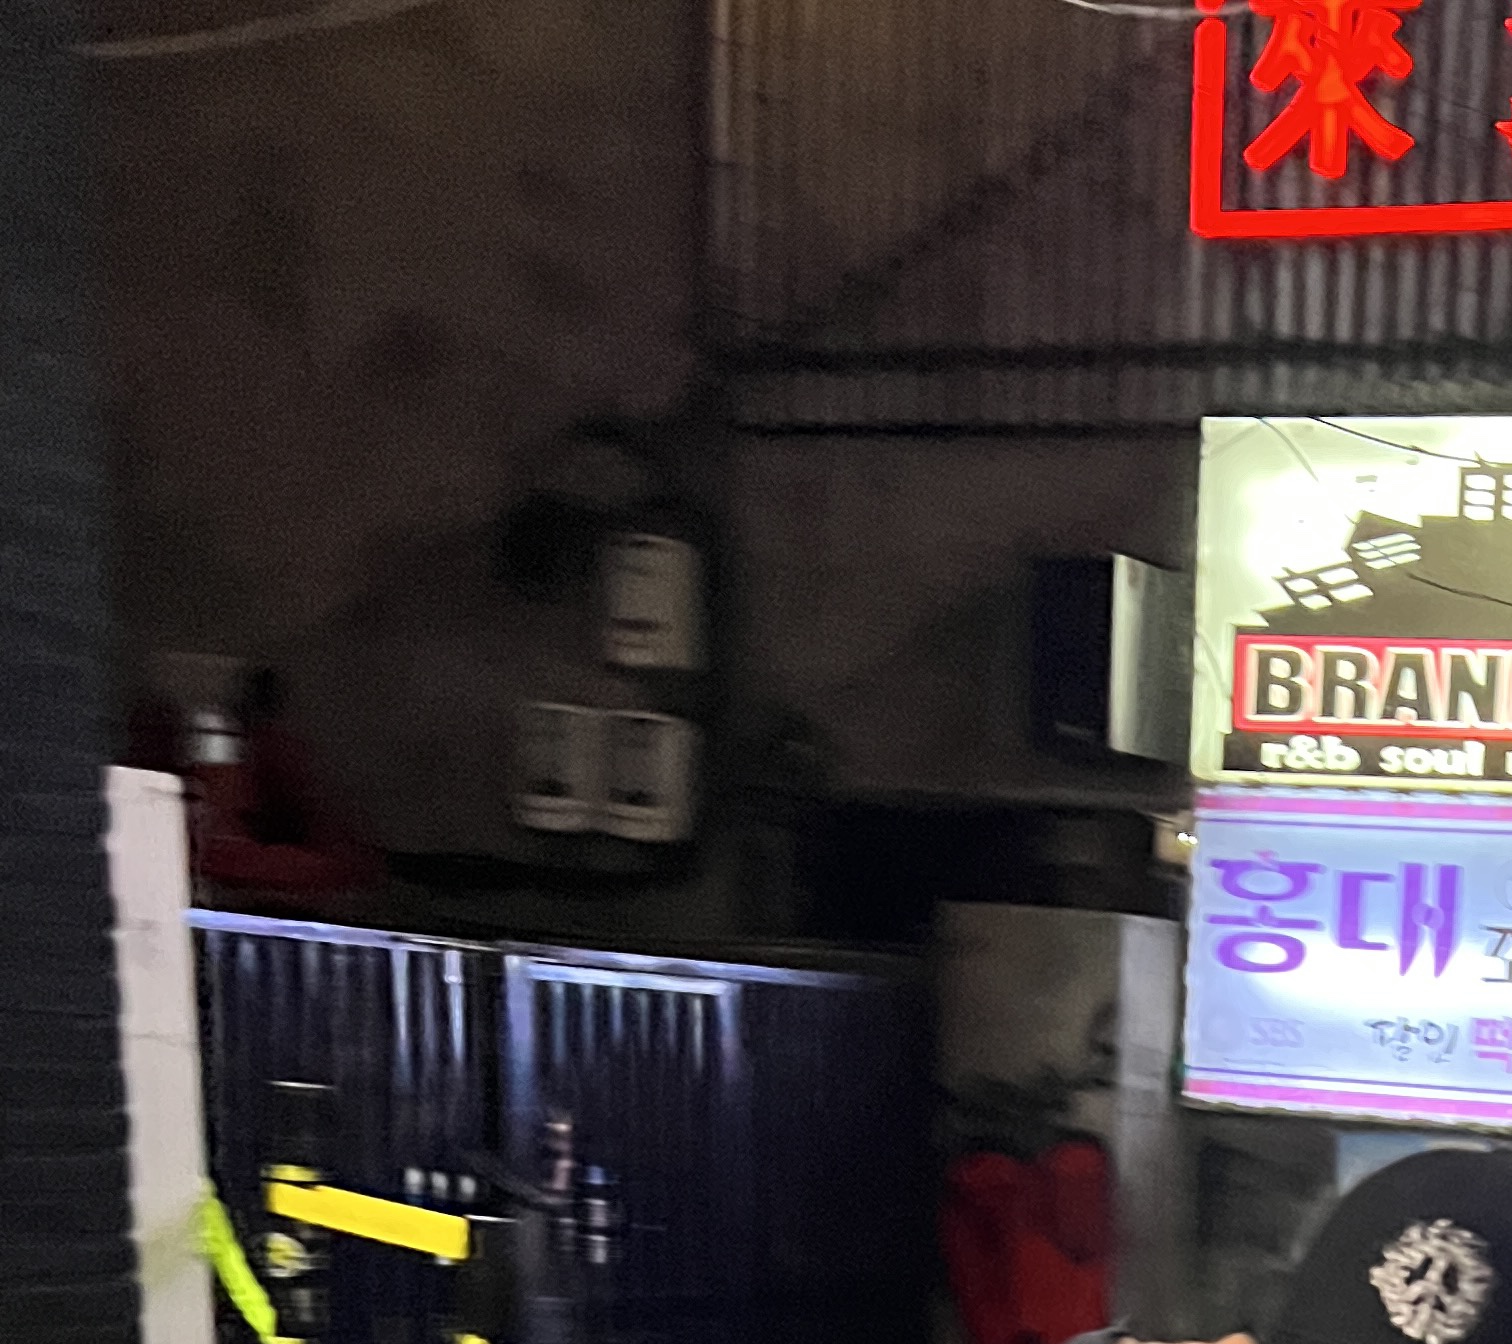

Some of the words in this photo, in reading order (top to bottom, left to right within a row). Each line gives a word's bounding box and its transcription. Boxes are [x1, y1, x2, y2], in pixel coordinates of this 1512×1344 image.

[1260, 734, 1361, 771] r&b
[1379, 740, 1486, 777] soul
[1204, 851, 1464, 978] 홍대
